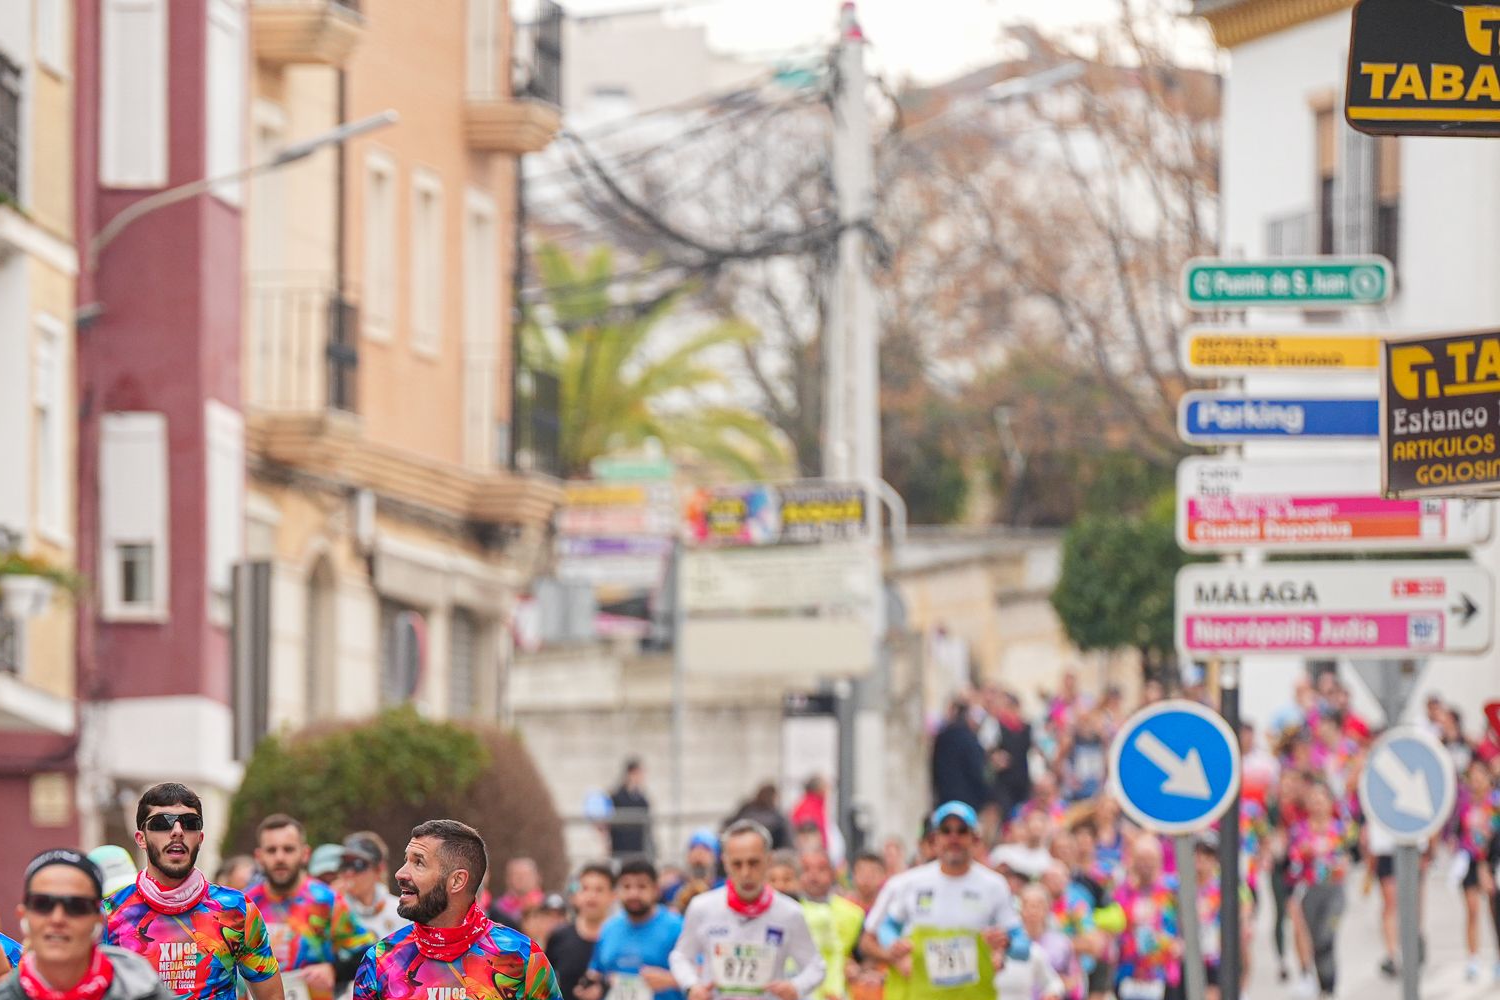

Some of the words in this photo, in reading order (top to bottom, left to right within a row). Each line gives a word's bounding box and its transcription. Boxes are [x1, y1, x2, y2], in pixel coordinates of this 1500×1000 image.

[1361, 62, 1500, 101] TABA
[1270, 271, 1291, 295] de
[1312, 271, 1348, 295] Juan
[1198, 401, 1304, 433] Parking
[1393, 406, 1488, 435] Estanco
[1393, 433, 1496, 461] ARTICULOS
[159, 943, 183, 961] XII
[184, 943, 197, 955] 08
[159, 961, 183, 971] MEDIA
[159, 968, 196, 980] MARATÓN
[452, 987, 467, 1000] 08
